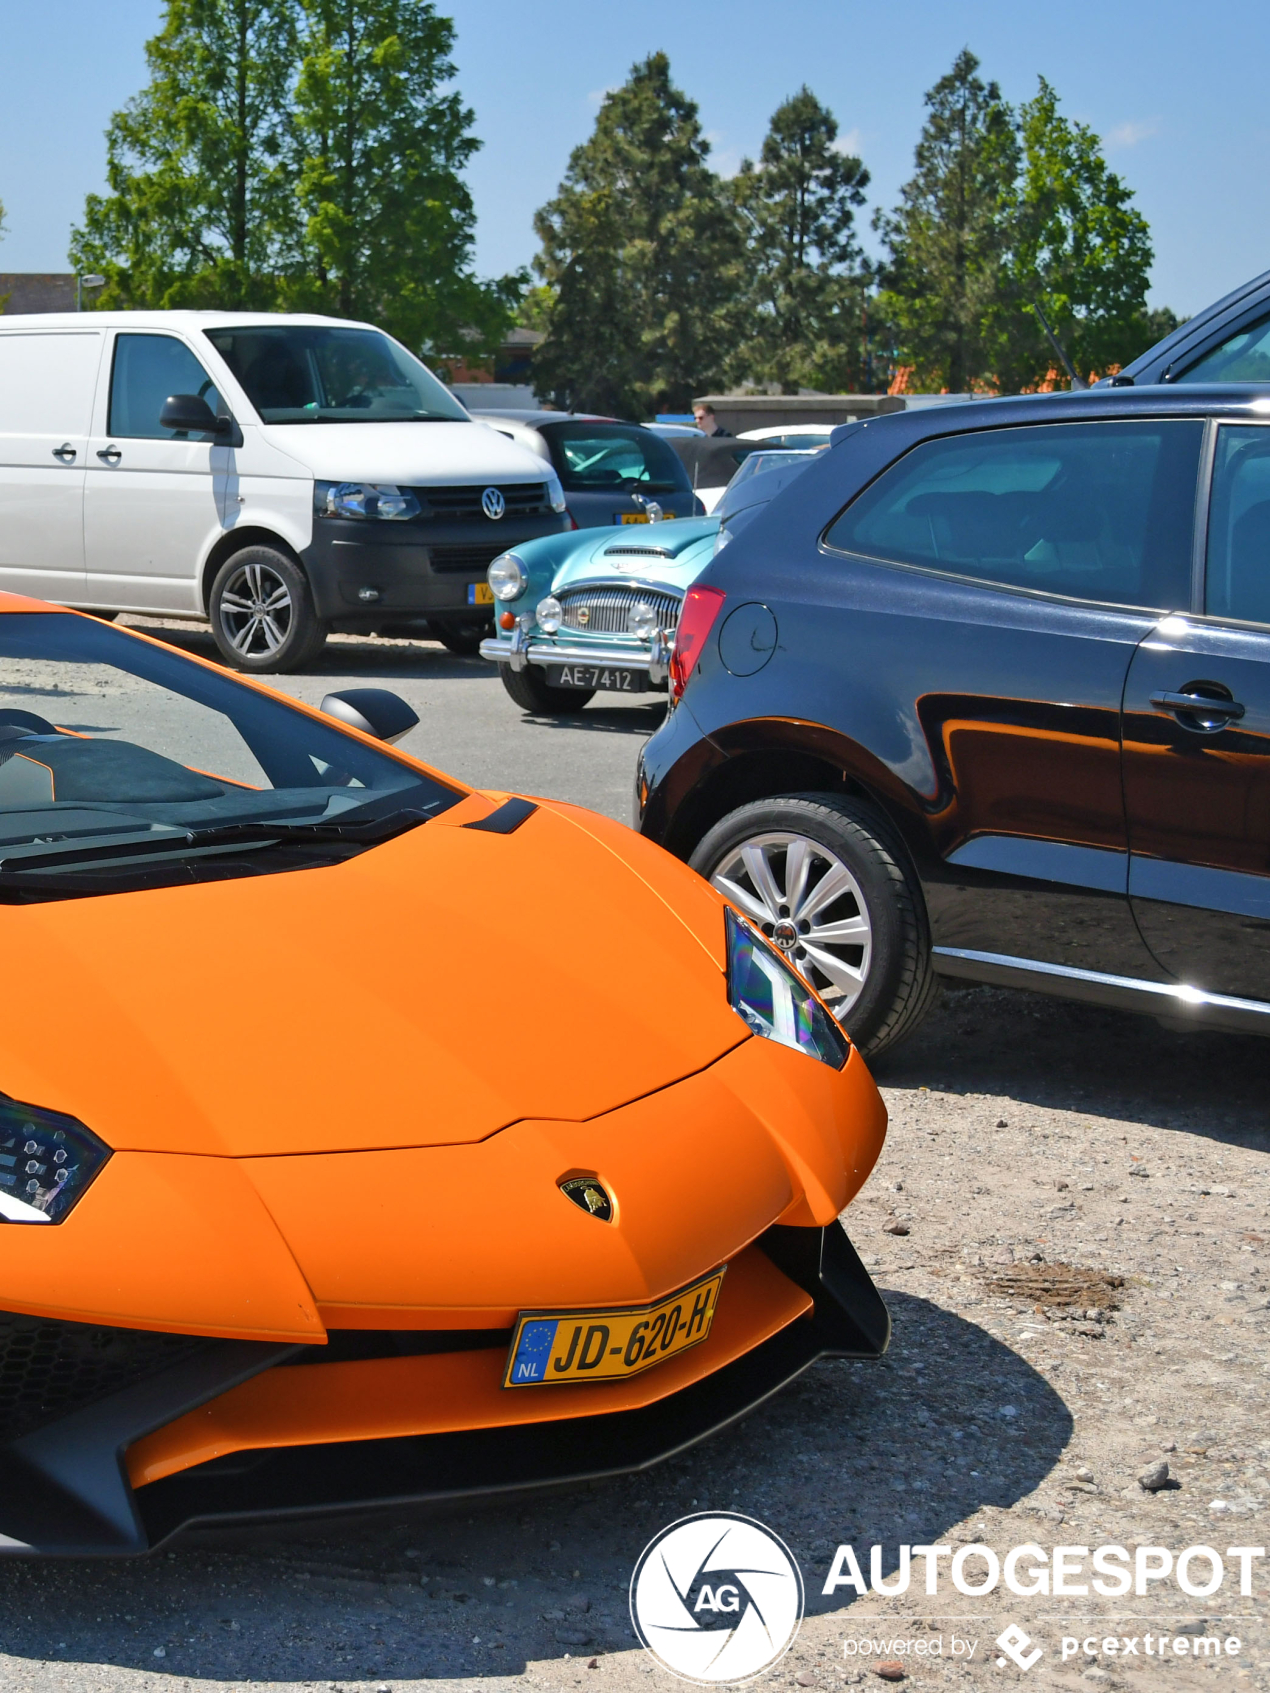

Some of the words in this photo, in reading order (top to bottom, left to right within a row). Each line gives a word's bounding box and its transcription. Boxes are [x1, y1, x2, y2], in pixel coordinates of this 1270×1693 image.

[560, 666, 631, 690] AE-74-12
[553, 1288, 712, 1373] JD-620-H
[518, 1362, 538, 1378] NL
